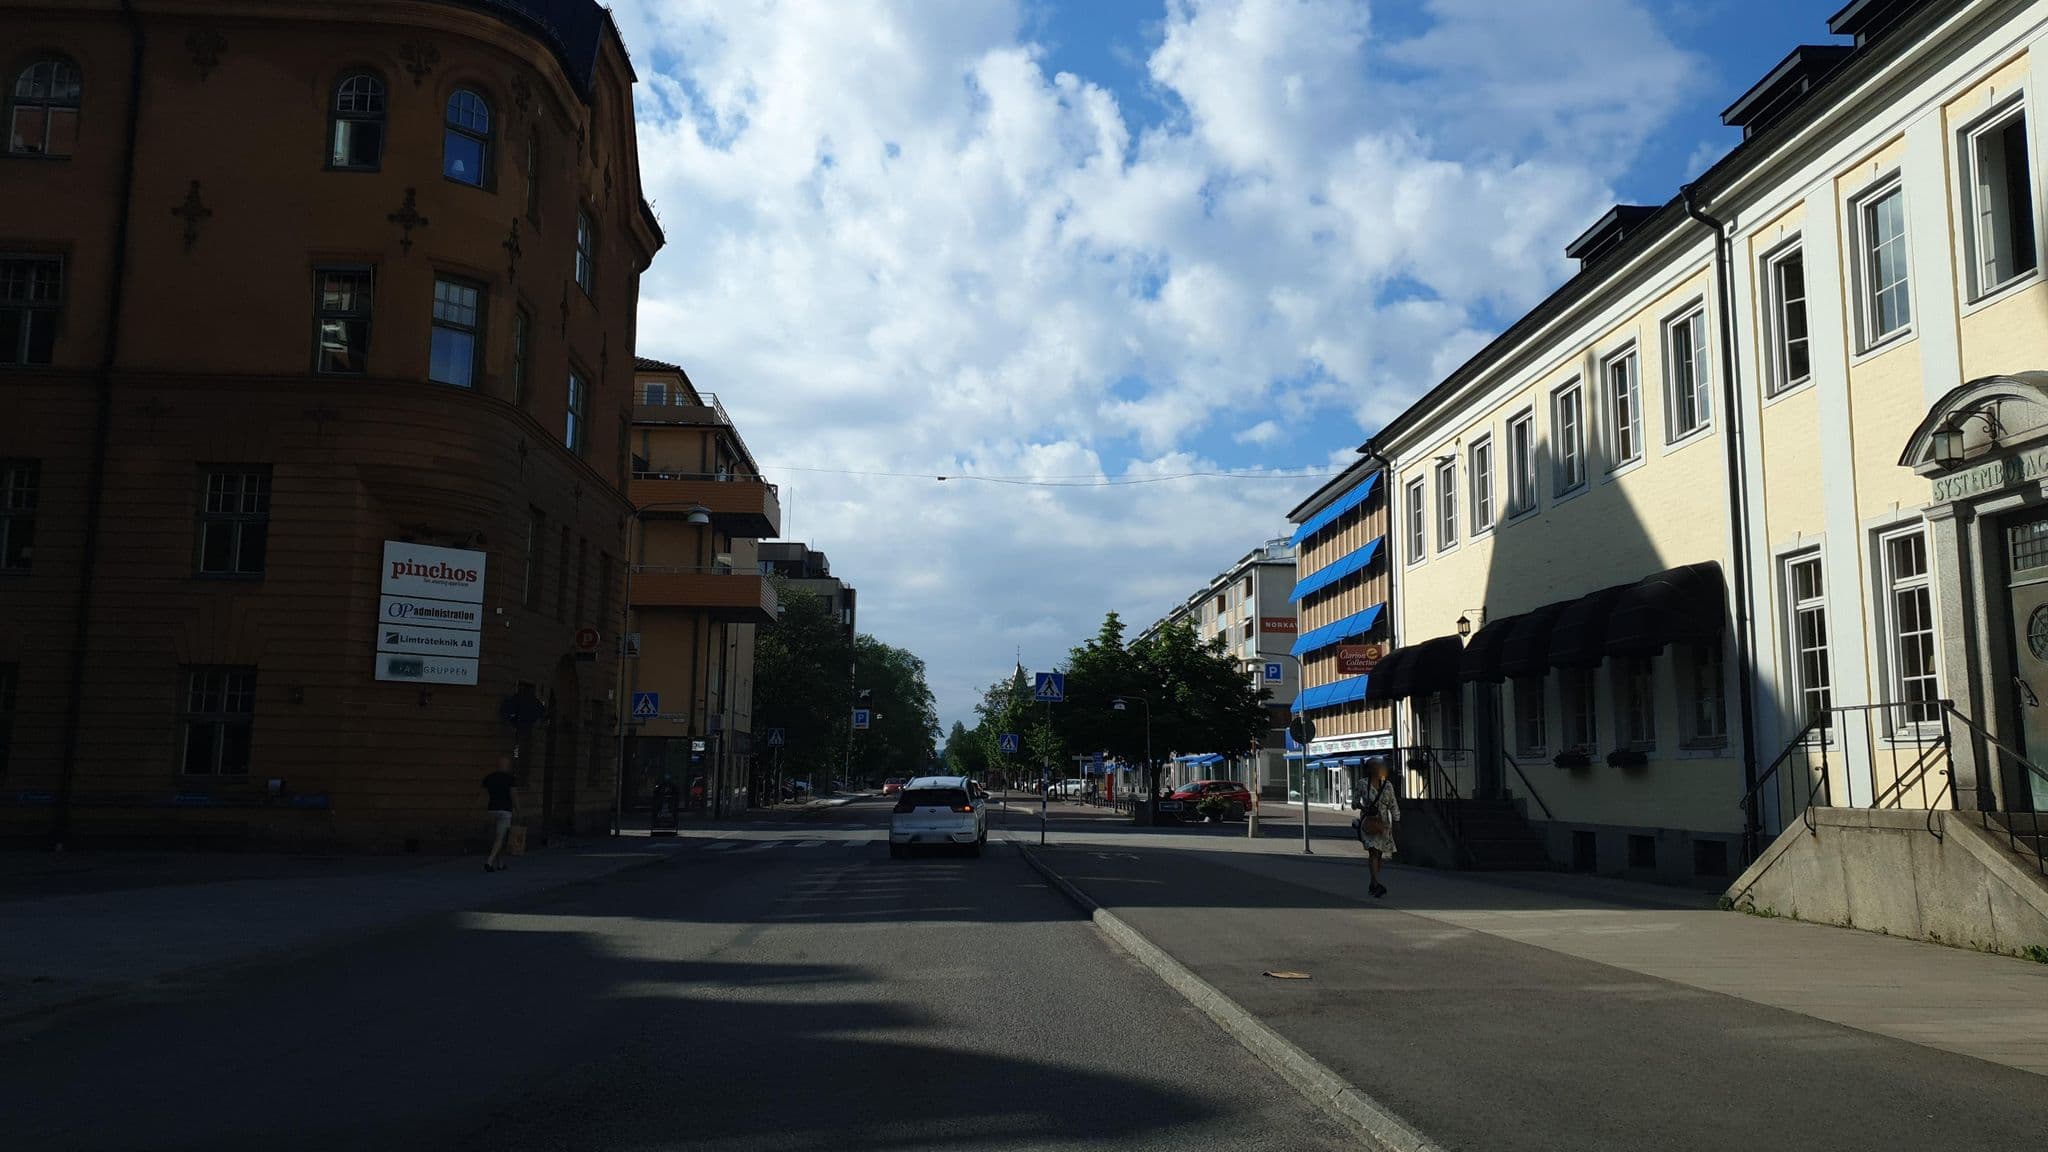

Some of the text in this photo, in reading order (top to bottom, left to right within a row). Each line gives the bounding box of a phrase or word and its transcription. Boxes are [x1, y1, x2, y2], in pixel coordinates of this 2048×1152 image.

[391, 557, 478, 583] pinchos
[460, 639, 474, 648] AB
[1340, 649, 1367, 659] Clarion
[423, 665, 468, 677] GRUPPEN
[1269, 666, 1278, 678] P
